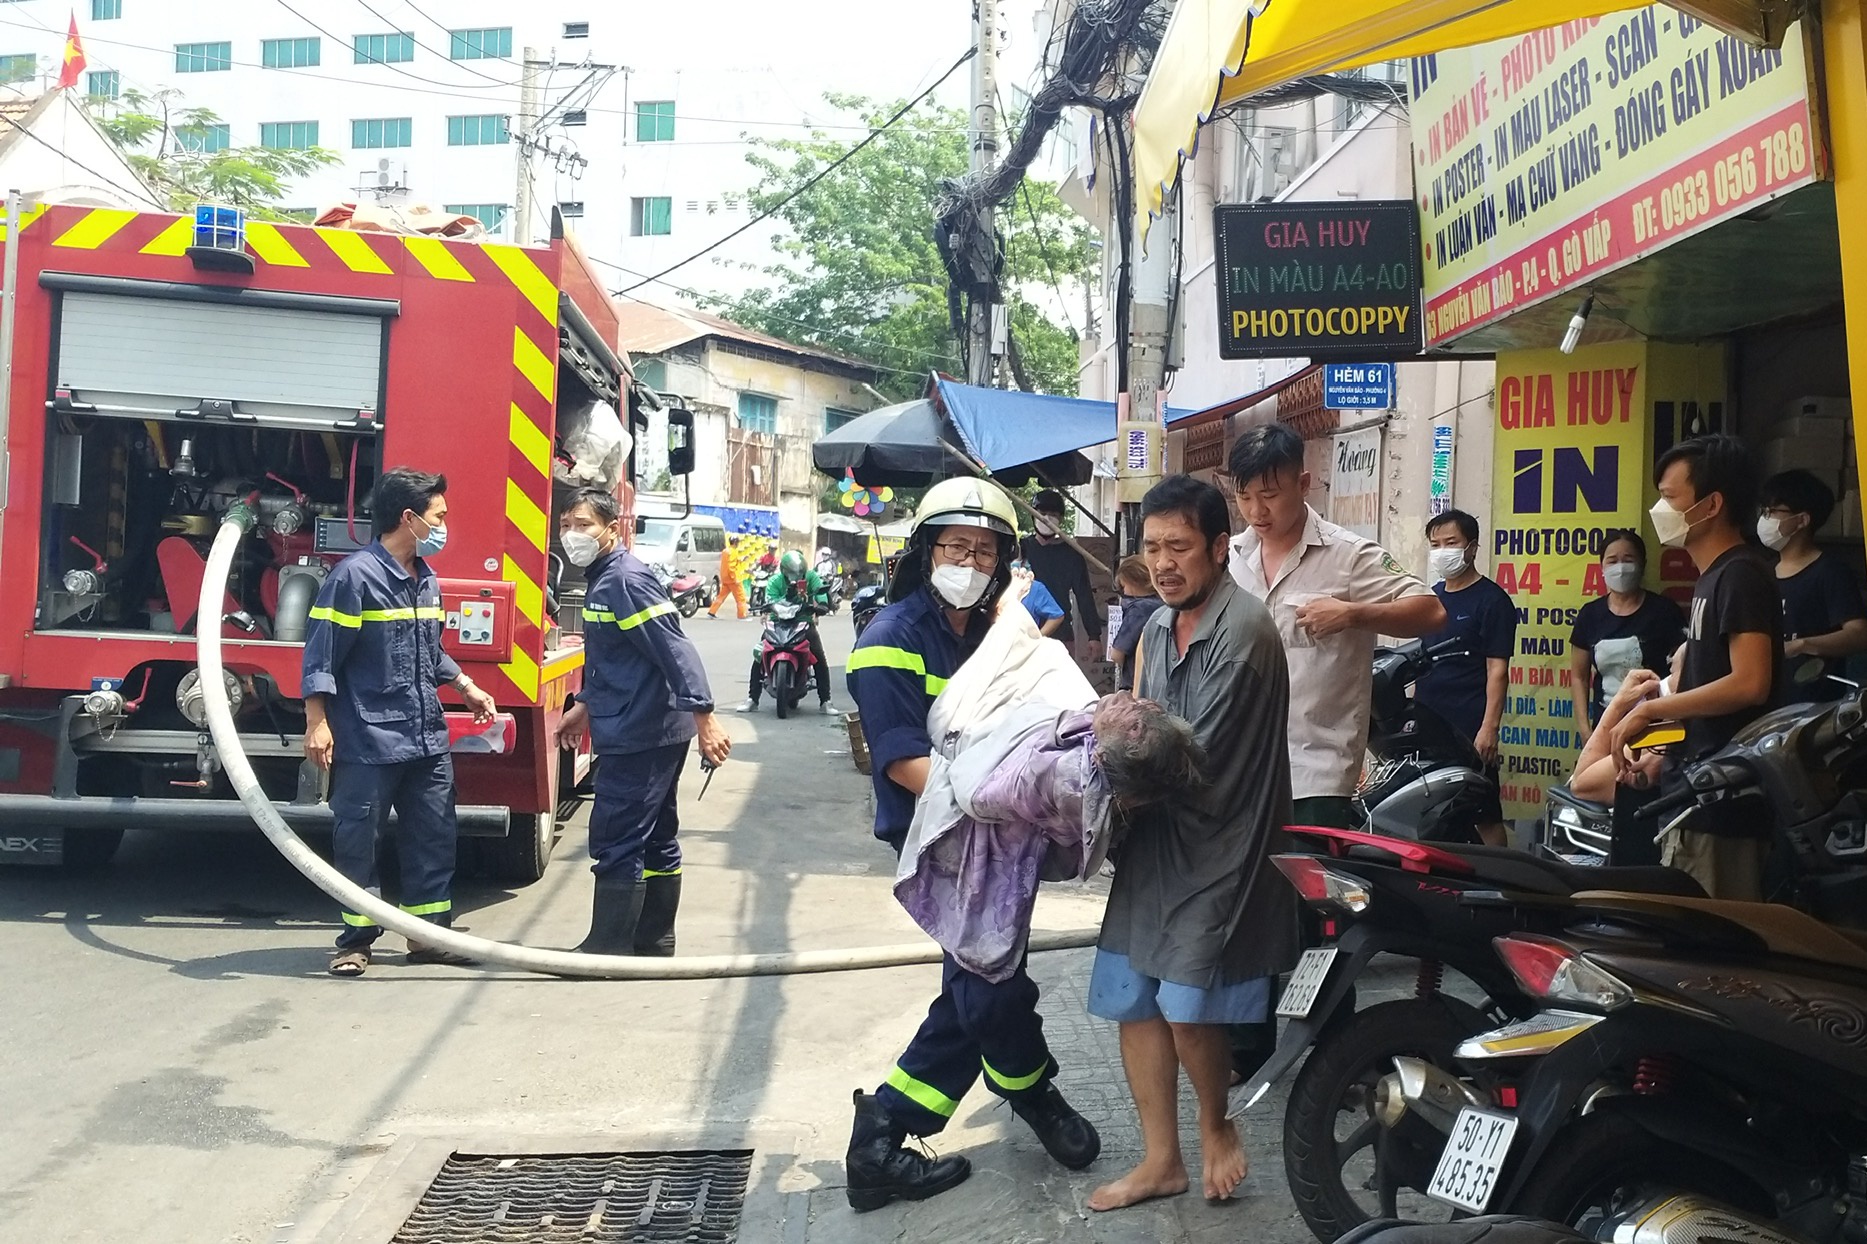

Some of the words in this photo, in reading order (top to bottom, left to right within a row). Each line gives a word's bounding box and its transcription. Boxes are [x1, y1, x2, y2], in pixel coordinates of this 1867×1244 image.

[1428, 121, 1441, 166] IN
[1501, 27, 1556, 102] PHOTO
[1432, 176, 1444, 219] IN
[1445, 143, 1485, 208] POSTER
[1494, 122, 1509, 172] IN
[1510, 98, 1542, 160] MÀU
[1544, 57, 1591, 134] LASER
[1606, 5, 1658, 89] SCAN
[1436, 229, 1447, 270] IN
[1506, 175, 1527, 228] MẠ
[1559, 123, 1601, 192] VÀNG
[1614, 80, 1667, 160] ĐÓNG
[1671, 48, 1709, 126] GÁY
[1563, 231, 1582, 277] GÒ
[1583, 211, 1611, 266] VẤP
[1660, 170, 1710, 231] 0933
[1714, 147, 1757, 206] 056
[1760, 122, 1806, 186] 788
[1264, 221, 1310, 248] GIA
[1318, 219, 1371, 247] HUY
[1232, 266, 1259, 294] IN
[1269, 259, 1323, 293] MÀU
[1232, 306, 1410, 338] PHOTOCOPPY
[1367, 369, 1382, 383] 61
[1500, 374, 1556, 431] GIA
[1567, 366, 1638, 426] HUY
[1495, 528, 1637, 555] PHOTOCO
[1496, 563, 1543, 595] A4
[1536, 607, 1580, 626] POS
[1521, 635, 1564, 656] MÀU
[1501, 726, 1531, 746] CAN
[1536, 726, 1570, 749] MÀU
[1508, 755, 1561, 777] PLASTIC
[1457, 1114, 1506, 1160] 50-Y1
[1436, 1154, 1495, 1206] 485.35
